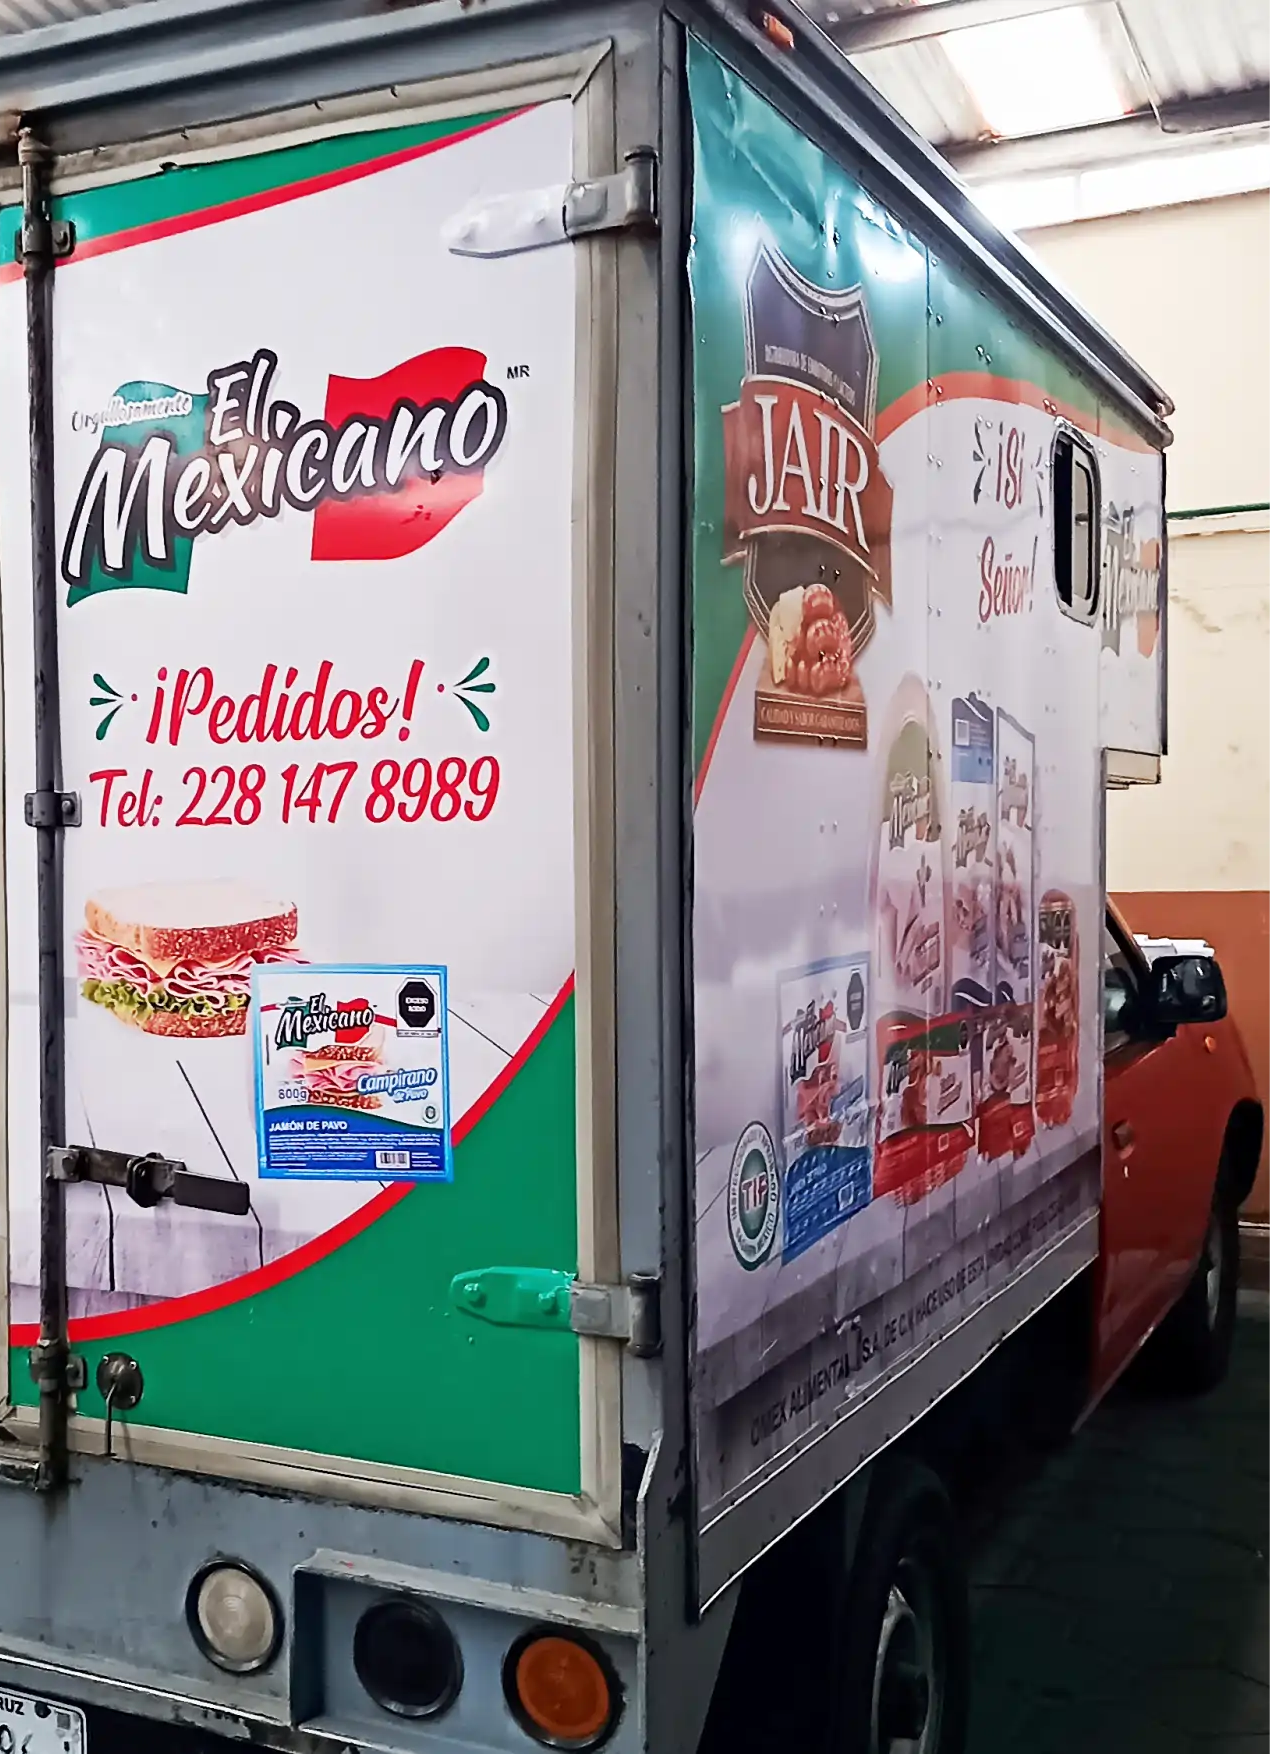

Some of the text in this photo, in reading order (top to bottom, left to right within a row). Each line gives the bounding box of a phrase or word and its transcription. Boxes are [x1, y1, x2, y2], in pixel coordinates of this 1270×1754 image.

[506, 364, 531, 378] MR
[207, 348, 278, 447] El
[61, 378, 510, 588] Mexicano
[748, 394, 870, 554] JAIR
[89, 755, 501, 828] Tel: 228 147 8989
[275, 1006, 375, 1048] Mexicano
[356, 1067, 438, 1096] Campirano
[269, 1121, 348, 1132] JAMÓN DE PAVO
[742, 1171, 768, 1213] TIF
